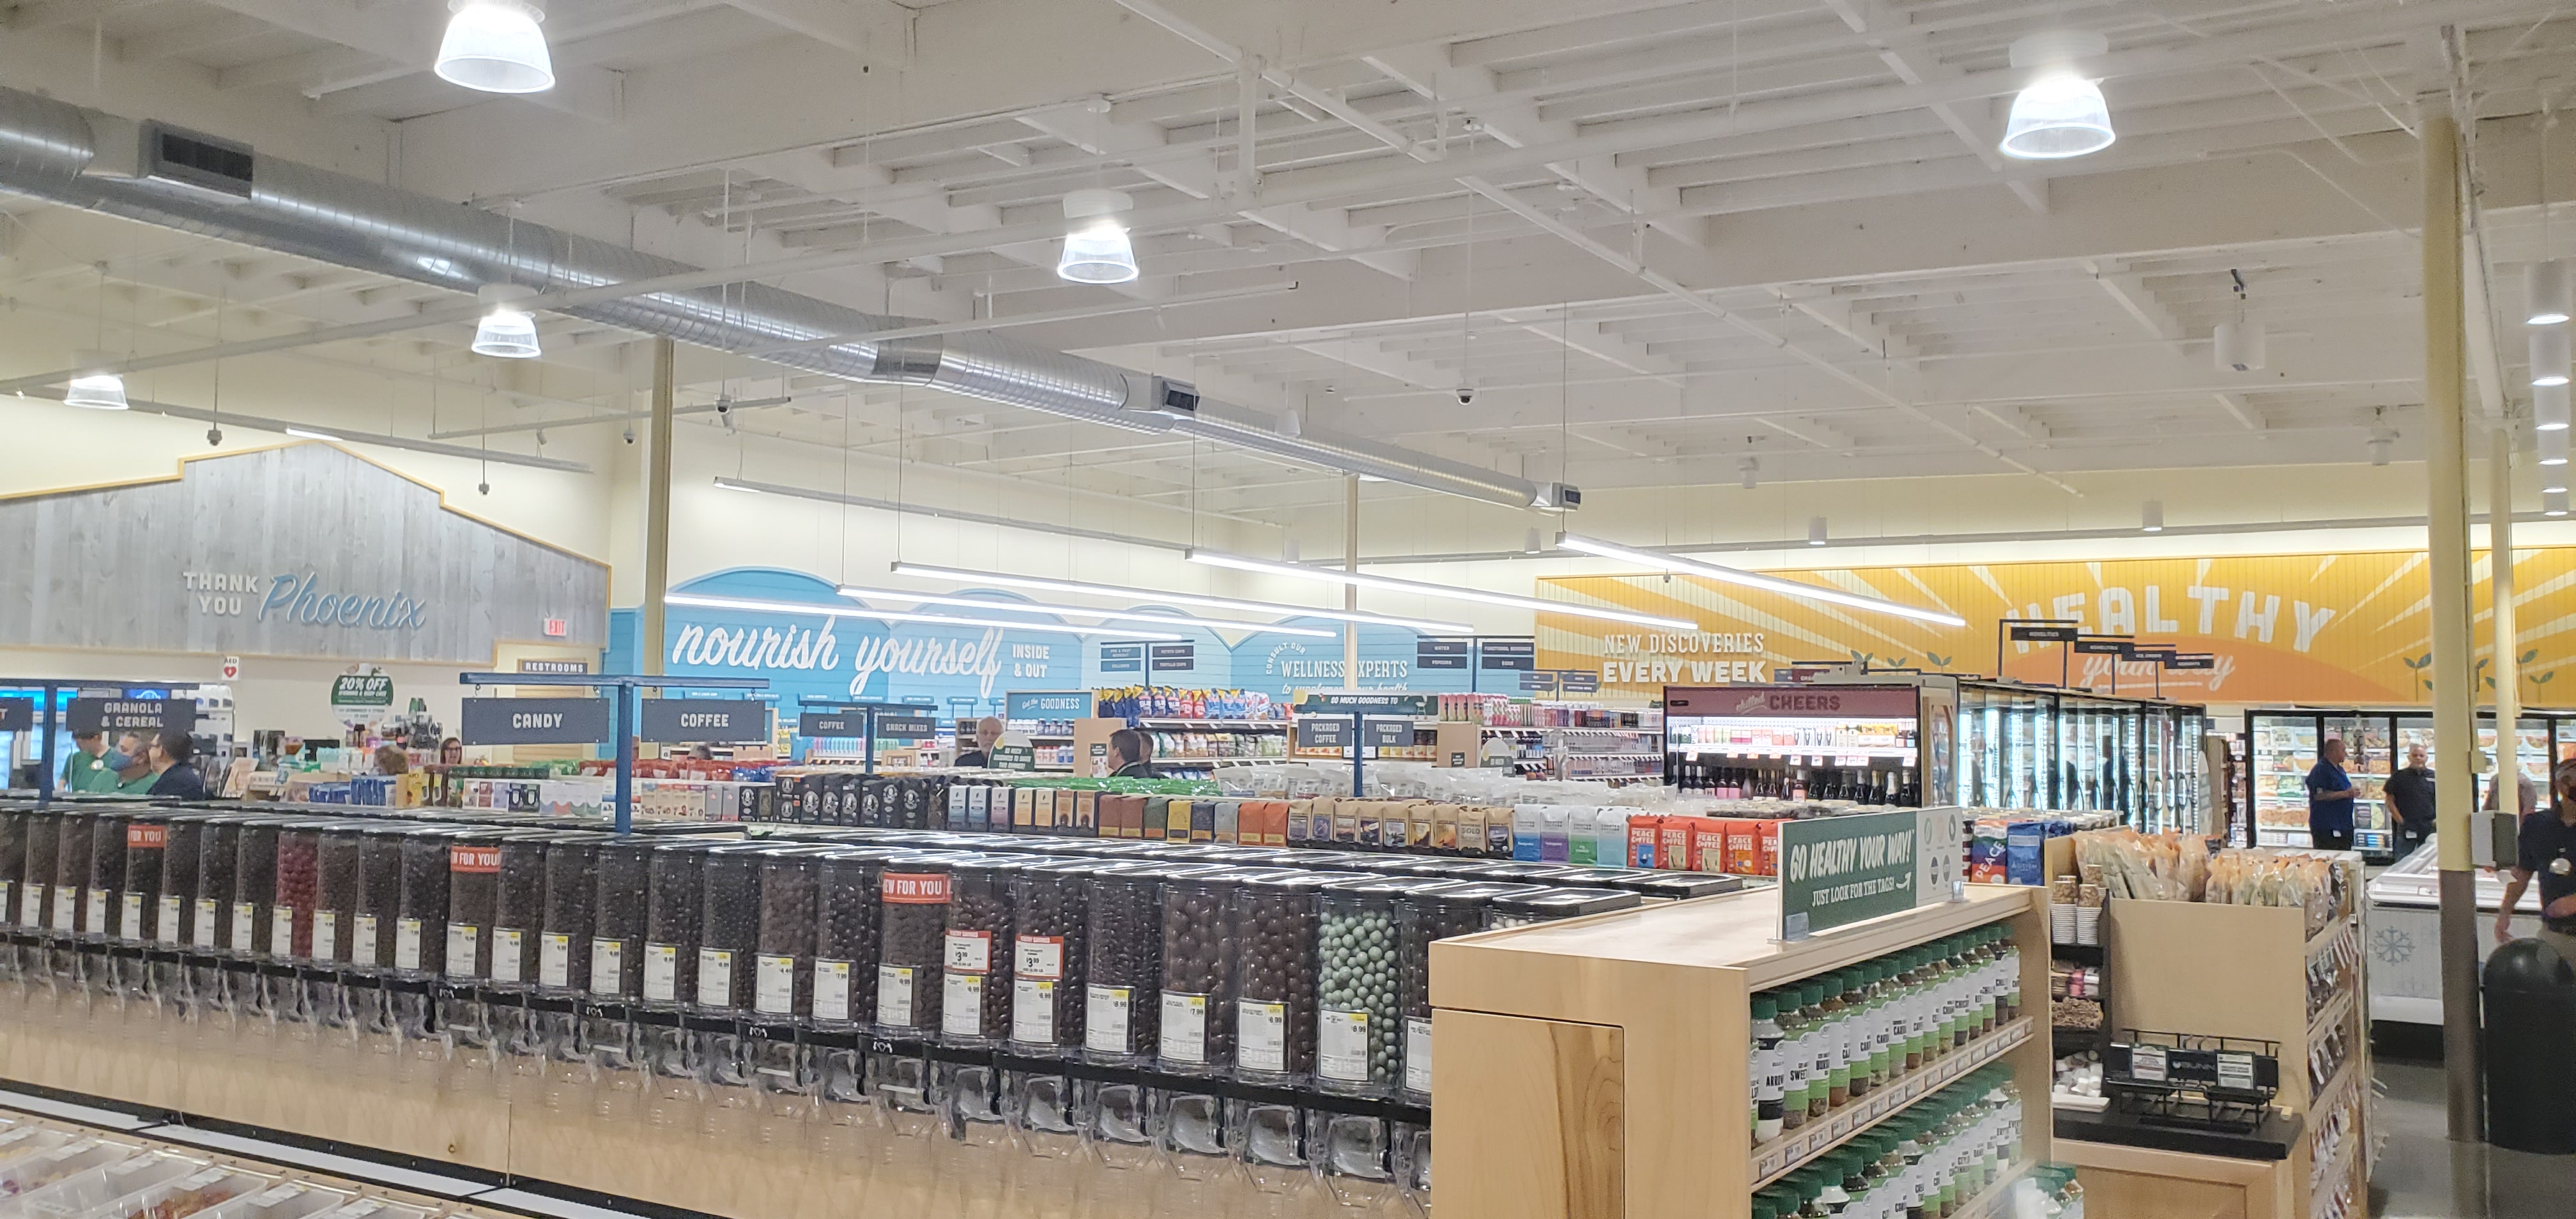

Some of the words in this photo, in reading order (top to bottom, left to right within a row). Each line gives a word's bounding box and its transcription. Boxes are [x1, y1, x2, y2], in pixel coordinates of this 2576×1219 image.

[183, 572, 258, 593] THANK
[199, 596, 241, 615] YOU
[257, 571, 426, 629] Phoenix
[549, 620, 565, 634] EXIT
[2005, 585, 2336, 654] HEALTHY
[1604, 634, 1641, 653] NEW
[1649, 632, 1765, 653] DISCOVERIES
[673, 615, 839, 670] nourish
[850, 627, 1002, 698] yourself
[1012, 643, 1050, 660] INSIDE
[1266, 643, 1288, 675] CONSULT
[1291, 642, 1306, 655] OUR
[525, 662, 584, 673] RESTROOMS
[1014, 663, 1022, 677] &
[1026, 662, 1048, 678] OUT
[1281, 660, 1345, 678] WELLNESS
[1358, 660, 1408, 678] XPERTS
[1604, 661, 1683, 682] EVERY
[1690, 661, 1767, 682] WEEK
[339, 677, 364, 690] 20%
[365, 678, 388, 690] OFF
[1282, 684, 1291, 694] to
[103, 702, 163, 714] GRANOLA
[1041, 698, 1080, 710] GOODNESS
[1769, 694, 1841, 711] CHEERS
[101, 716, 110, 727] &
[116, 716, 164, 728] CEREAL
[512, 713, 564, 729] CANDY
[680, 713, 730, 728] COFFEE
[819, 721, 845, 730] COFFEE
[885, 723, 907, 732] SNACK
[908, 723, 928, 732] MIXES
[1311, 722, 1340, 733] PACKAGED
[1376, 723, 1402, 733] PACKAGED
[1315, 734, 1337, 744] COFFEE
[1382, 734, 1397, 744] BULK
[144, 830, 162, 842] YOU
[459, 852, 475, 866] FOR
[478, 853, 498, 866] YOU
[1790, 844, 1807, 884] GO
[1809, 838, 1857, 880] HEALTHY
[1860, 834, 1885, 872] YOUR
[1975, 841, 2006, 879] PEACE
[897, 880, 916, 895] FOR
[919, 880, 942, 895] YOU
[1812, 889, 1830, 908] JUST
[1830, 884, 1850, 903] LOOK
[1850, 882, 1863, 899] FOR
[1864, 879, 1877, 897] THE
[1878, 876, 1895, 893] TAGS!
[2181, 1061, 2216, 1071] BUNN
